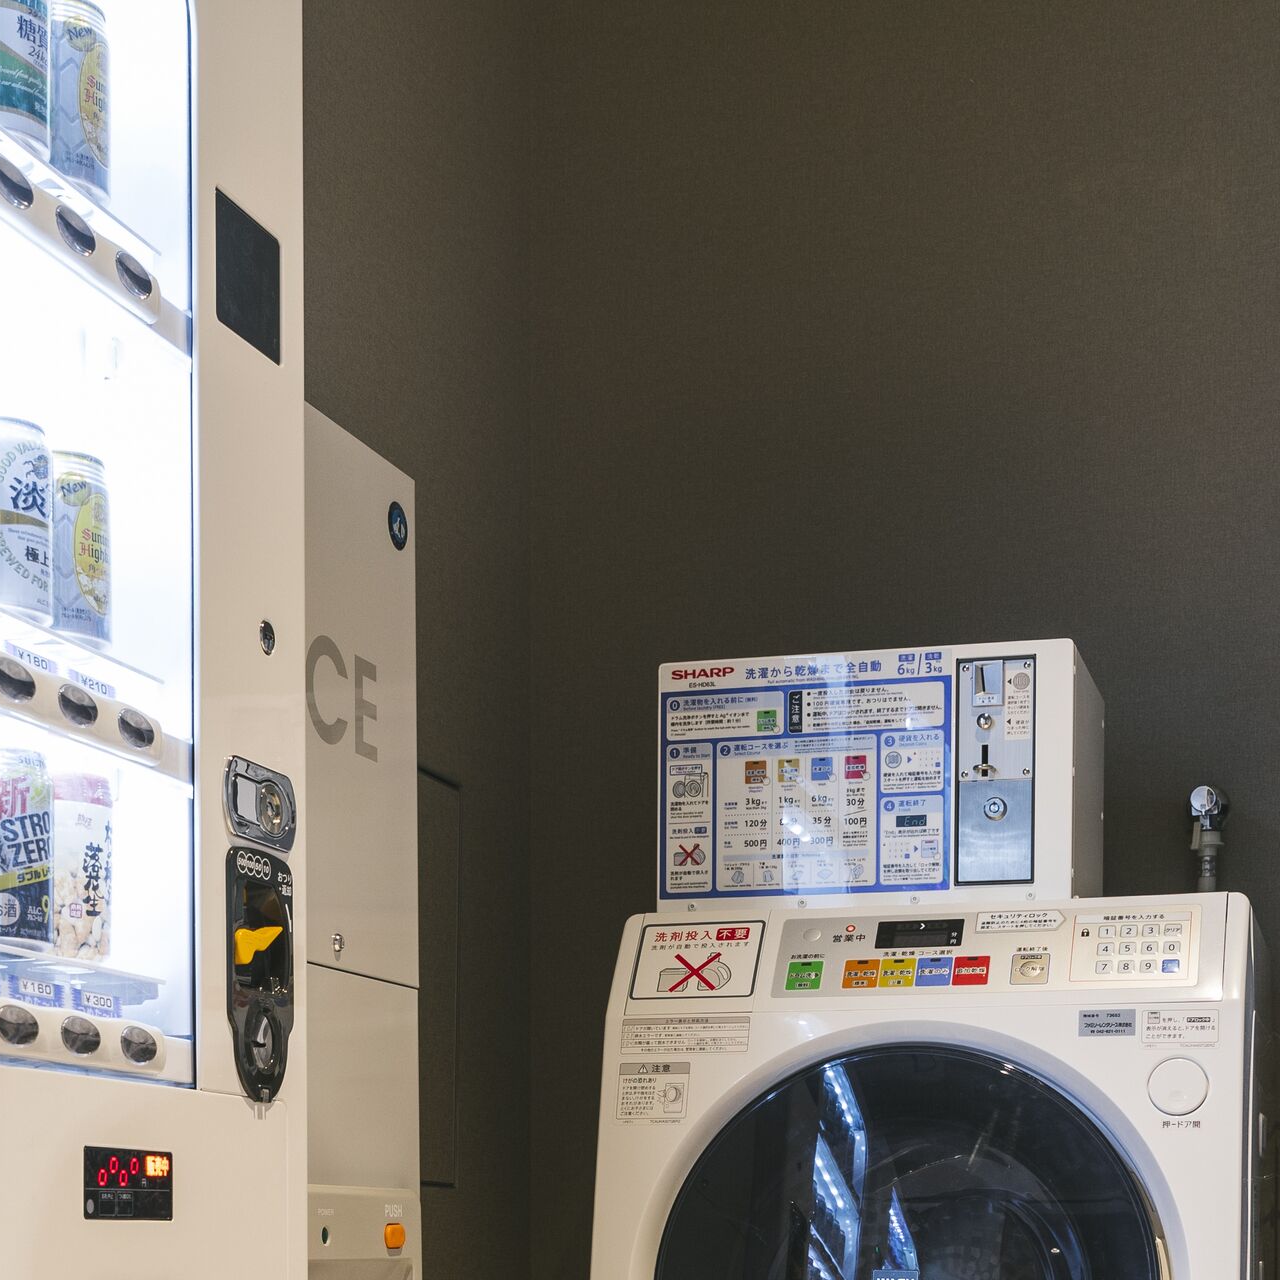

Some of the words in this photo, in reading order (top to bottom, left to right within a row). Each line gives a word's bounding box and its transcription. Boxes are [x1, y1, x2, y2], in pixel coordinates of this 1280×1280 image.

[69, 27, 93, 41] New
[59, 481, 88, 498] New
[18, 648, 48, 671] ¥180
[671, 667, 734, 680] SHARP
[745, 660, 882, 680] 洗濯から乾燥まで全自動
[80, 674, 108, 696] ¥210
[898, 734, 940, 743] 硬貨を入れる
[734, 742, 788, 752] 運転コースを選ぶ
[846, 798, 865, 807] 30分
[898, 799, 926, 807] 運転終了
[744, 819, 767, 828] 120分
[812, 816, 831, 825] 35分
[844, 817, 867, 826] 100円
[744, 839, 768, 848] 500円
[82, 842, 105, 917] 落花生
[654, 931, 713, 943] 洗剤投入
[719, 929, 747, 940] 不要
[832, 934, 866, 943] 営業中
[650, 941, 750, 951] 洗剤が自動で投入されます
[22, 980, 53, 996] ¥160
[85, 993, 113, 1009] ¥300
[652, 1064, 671, 1073] 注意
[317, 1208, 334, 1217] POWER
[384, 1204, 403, 1218] PUSH
